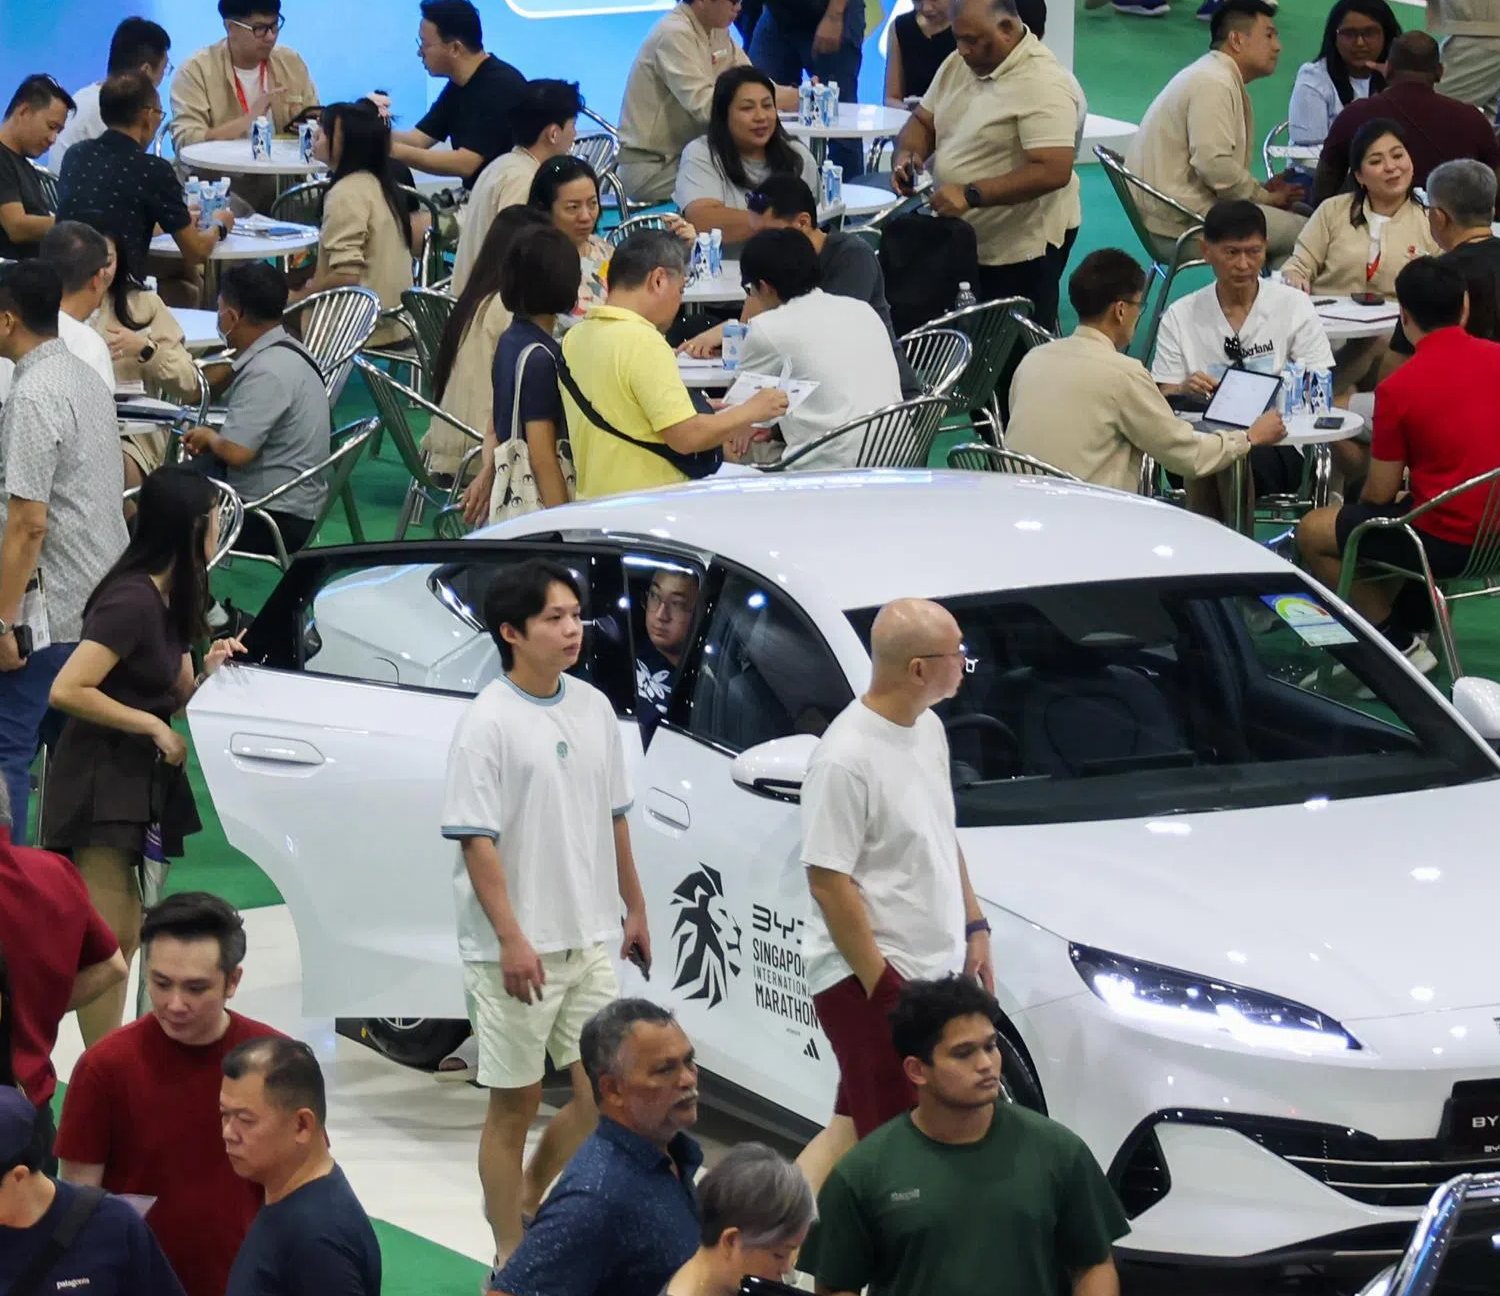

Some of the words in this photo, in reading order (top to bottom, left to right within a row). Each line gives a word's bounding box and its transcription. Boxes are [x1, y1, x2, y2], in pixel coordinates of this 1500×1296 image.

[752, 903, 806, 940] BY
[753, 965, 812, 998] INTERNATIONA
[755, 988, 820, 1030] MARATHON
[56, 1278, 90, 1289] patagonia
